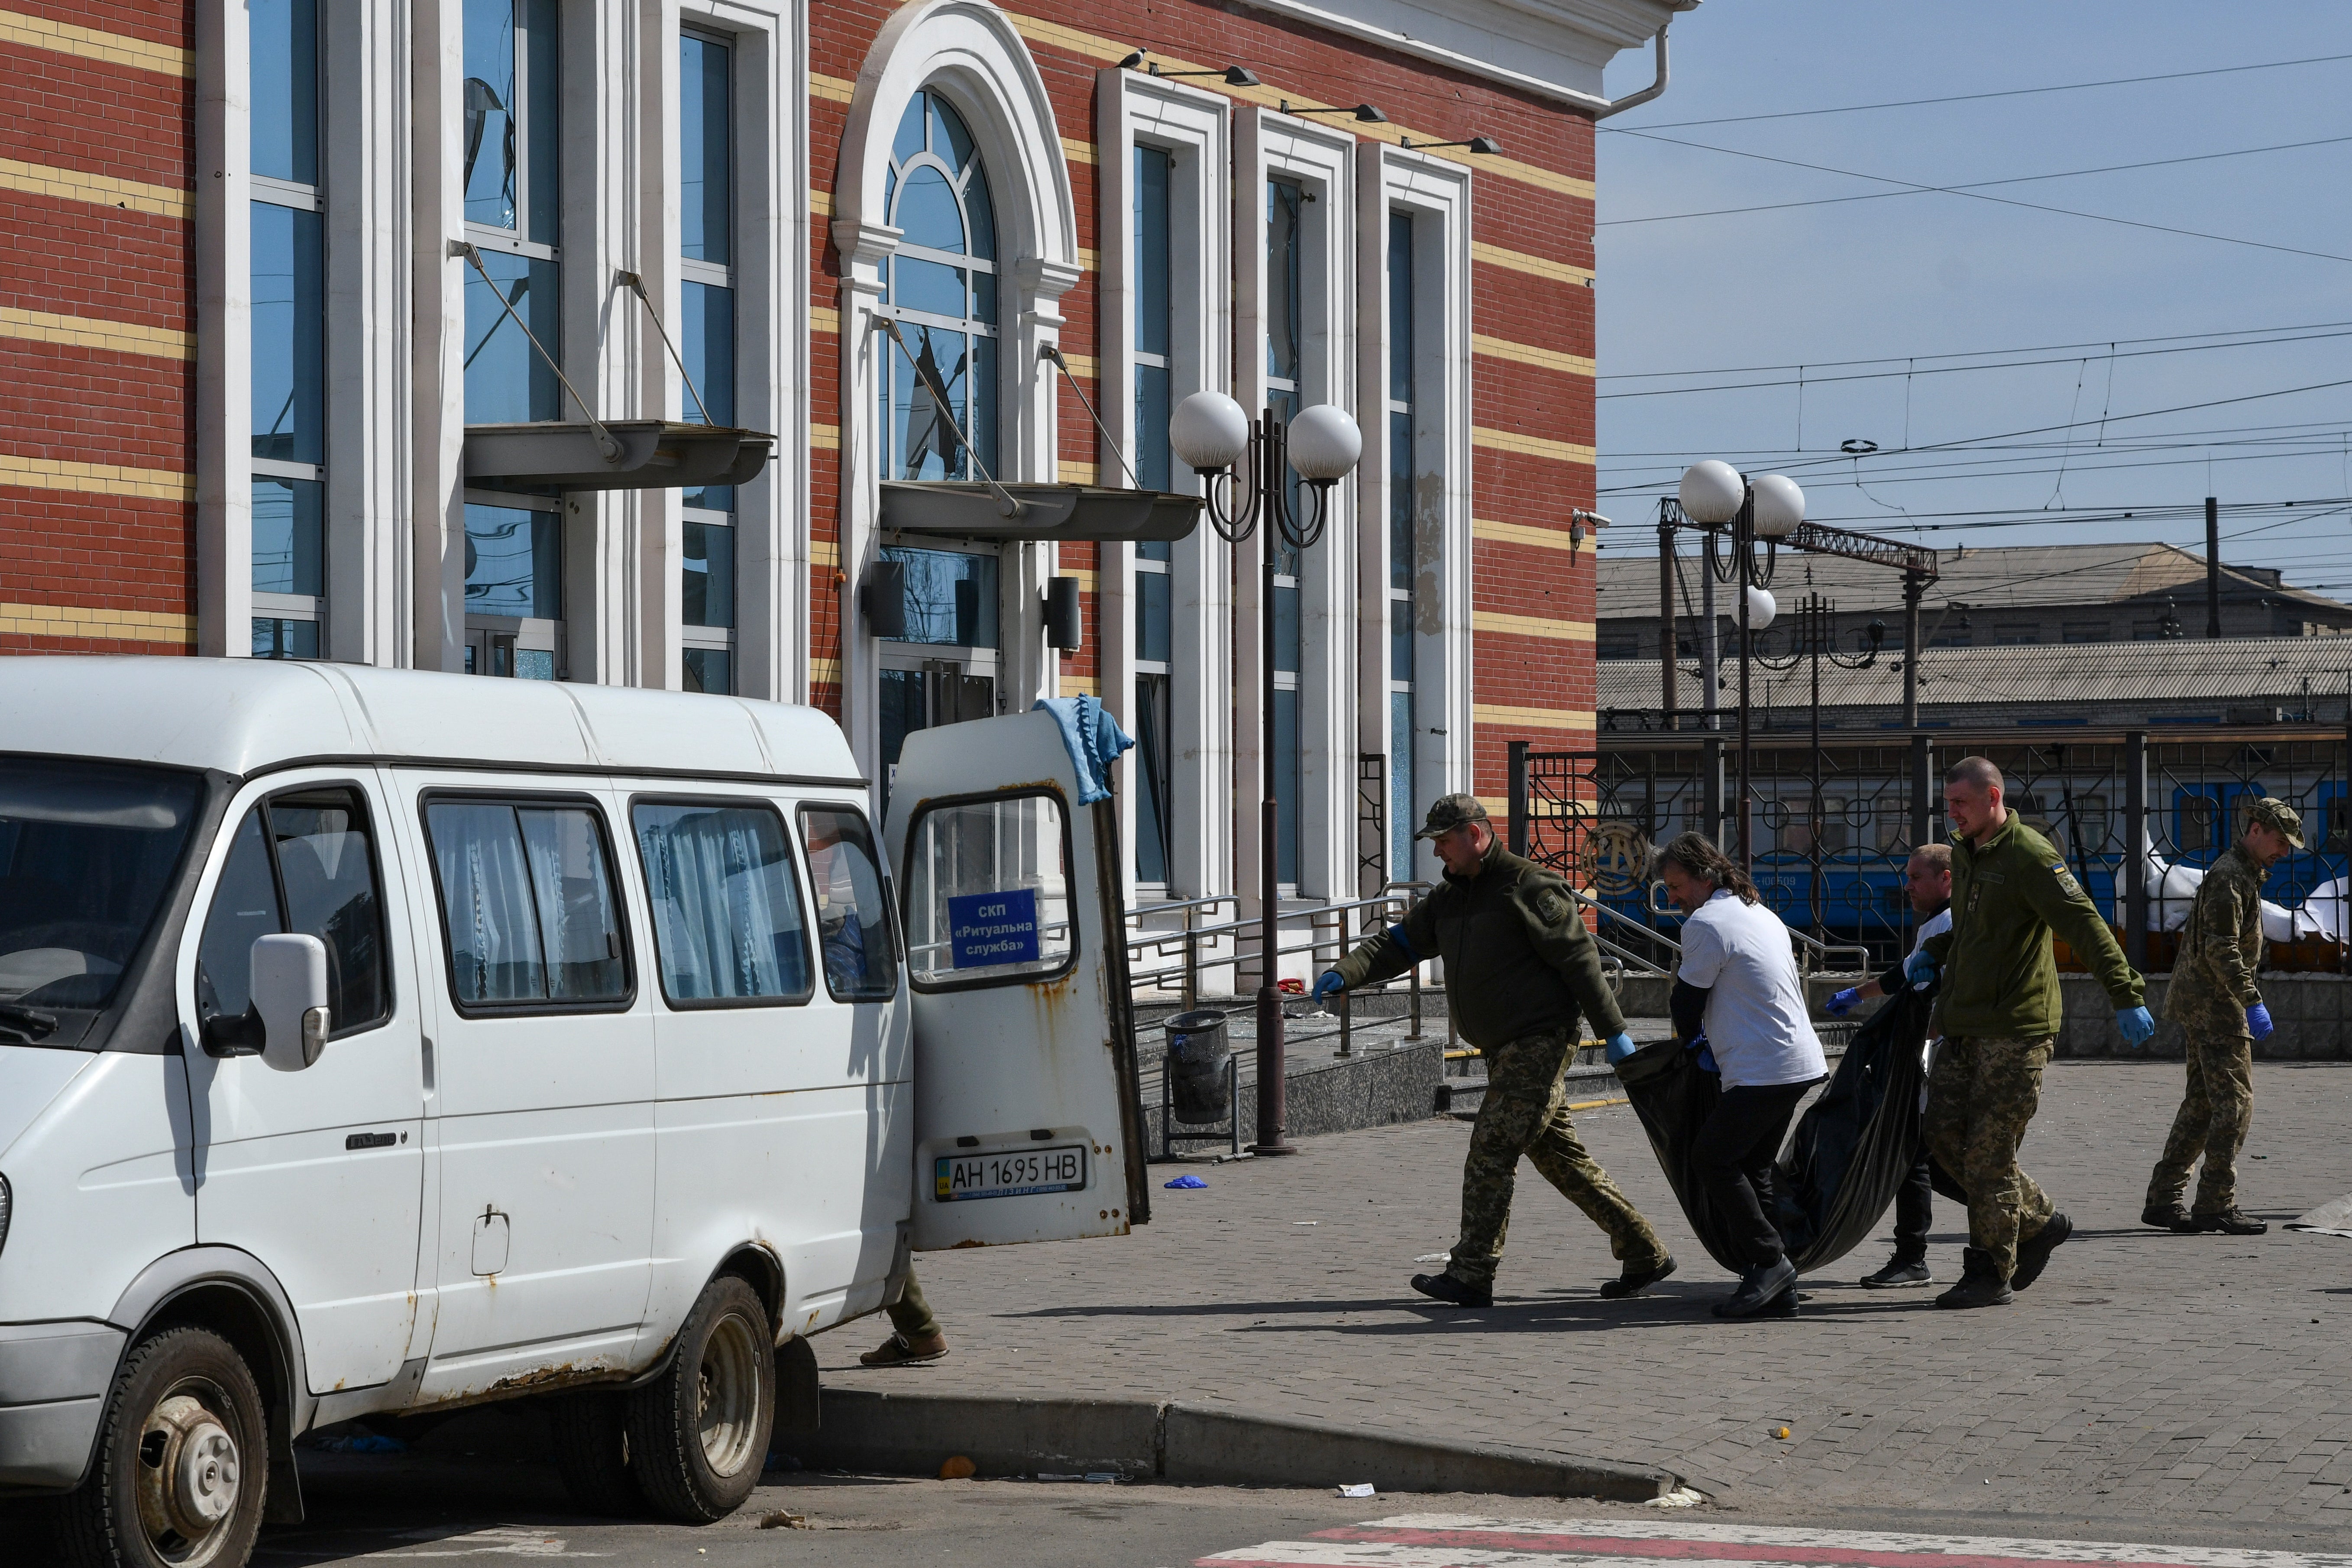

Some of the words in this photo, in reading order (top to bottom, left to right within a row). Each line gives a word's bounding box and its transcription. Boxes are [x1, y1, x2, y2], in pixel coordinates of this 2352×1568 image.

[978, 904, 1006, 918] СКП
[955, 922, 1032, 938] «Ритуальна
[966, 940, 1023, 956] служба»
[952, 1162, 983, 1189] AH
[991, 1157, 1039, 1185] 1695
[1045, 1155, 1077, 1181] HB
